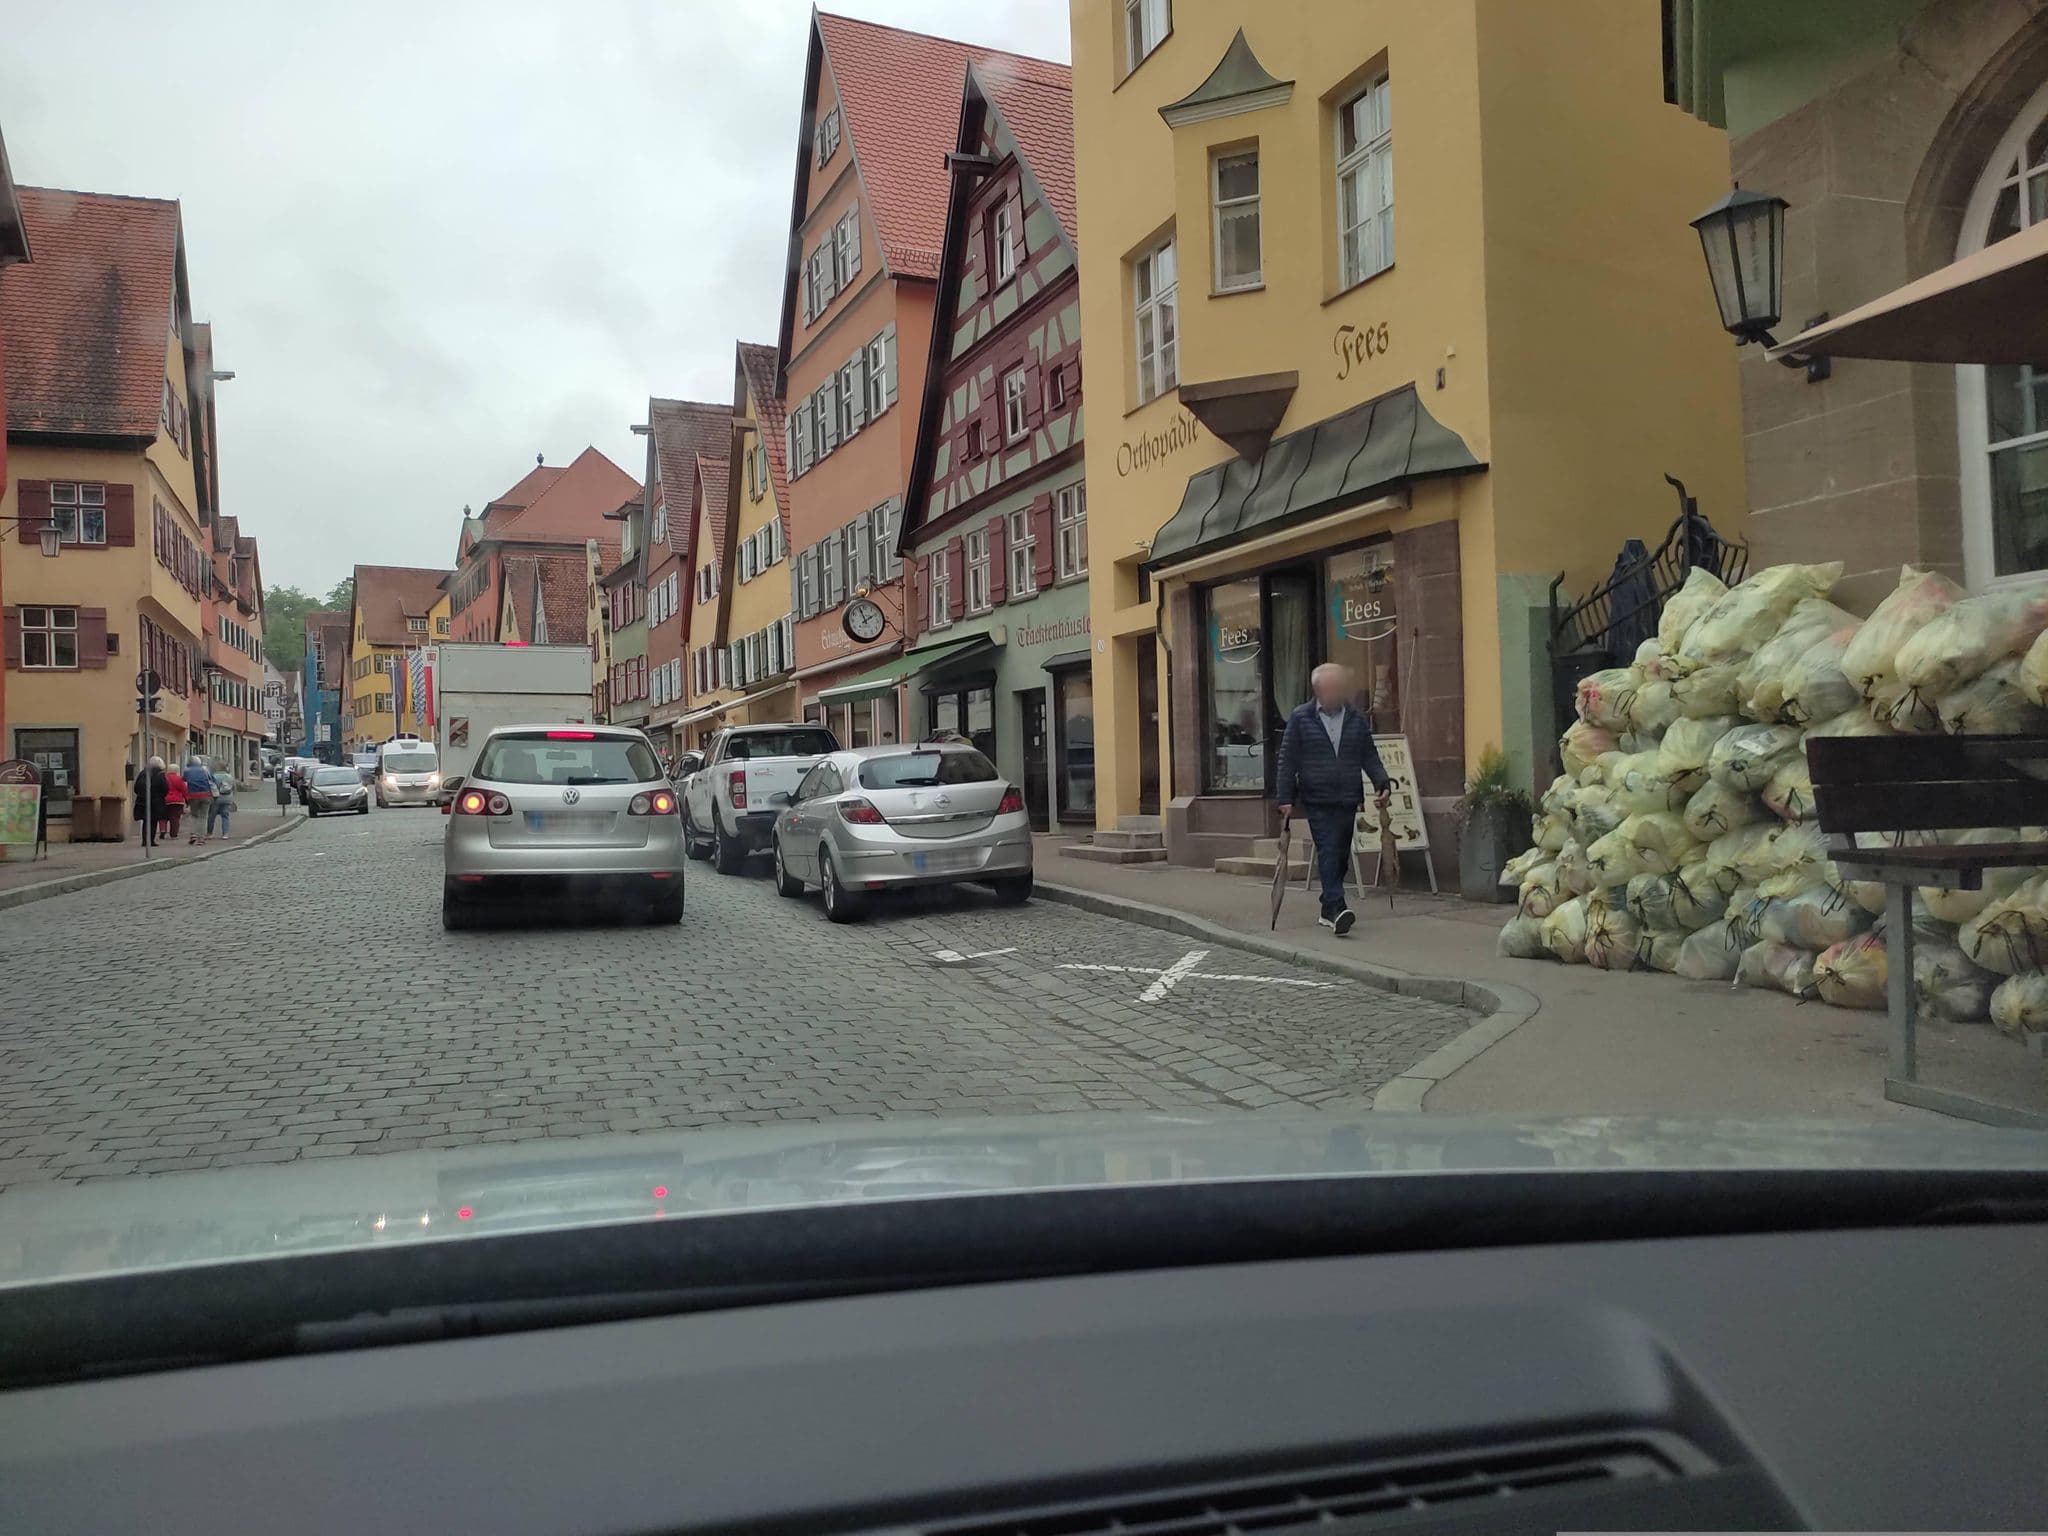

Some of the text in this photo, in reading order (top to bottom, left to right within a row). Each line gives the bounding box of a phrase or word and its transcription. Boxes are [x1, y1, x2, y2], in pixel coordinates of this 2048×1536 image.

[1333, 321, 1389, 380] Fees
[1116, 411, 1198, 477] Orthopädie
[1344, 599, 1381, 622] Fees
[1221, 627, 1248, 647] Fees
